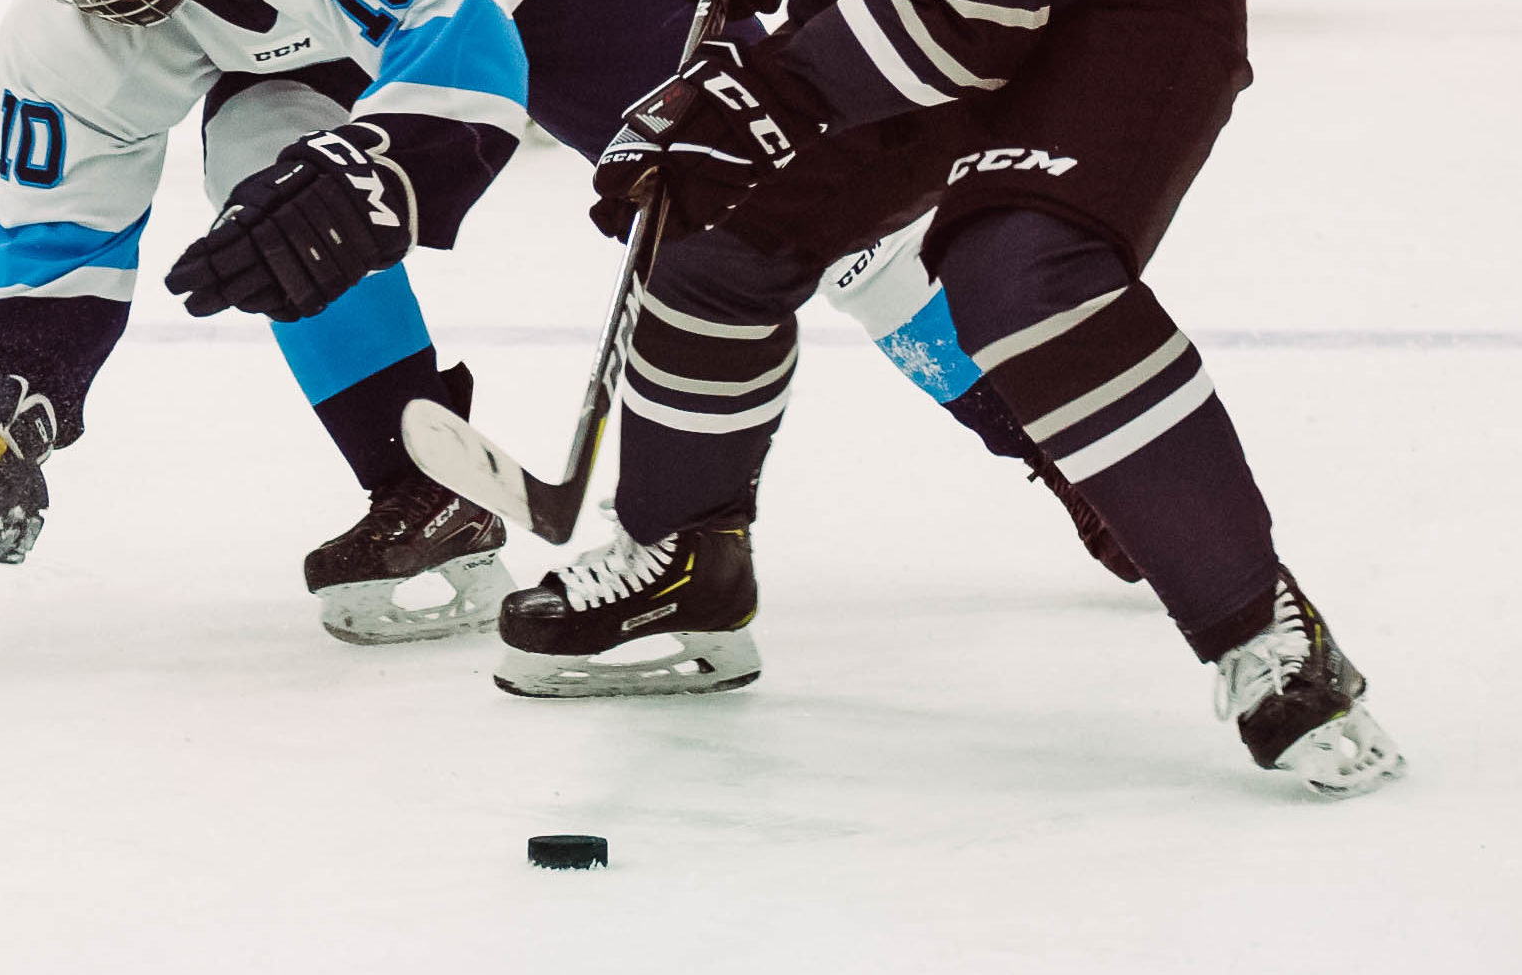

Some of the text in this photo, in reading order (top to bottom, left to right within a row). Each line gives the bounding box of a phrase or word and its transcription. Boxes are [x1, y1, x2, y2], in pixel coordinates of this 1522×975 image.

[253, 37, 312, 63] CCM
[0, 88, 67, 189] 10
[703, 71, 797, 170] CC
[303, 129, 401, 227] CM
[601, 152, 644, 165] CCM
[947, 148, 1078, 186] CCM
[423, 497, 460, 539] CCM
